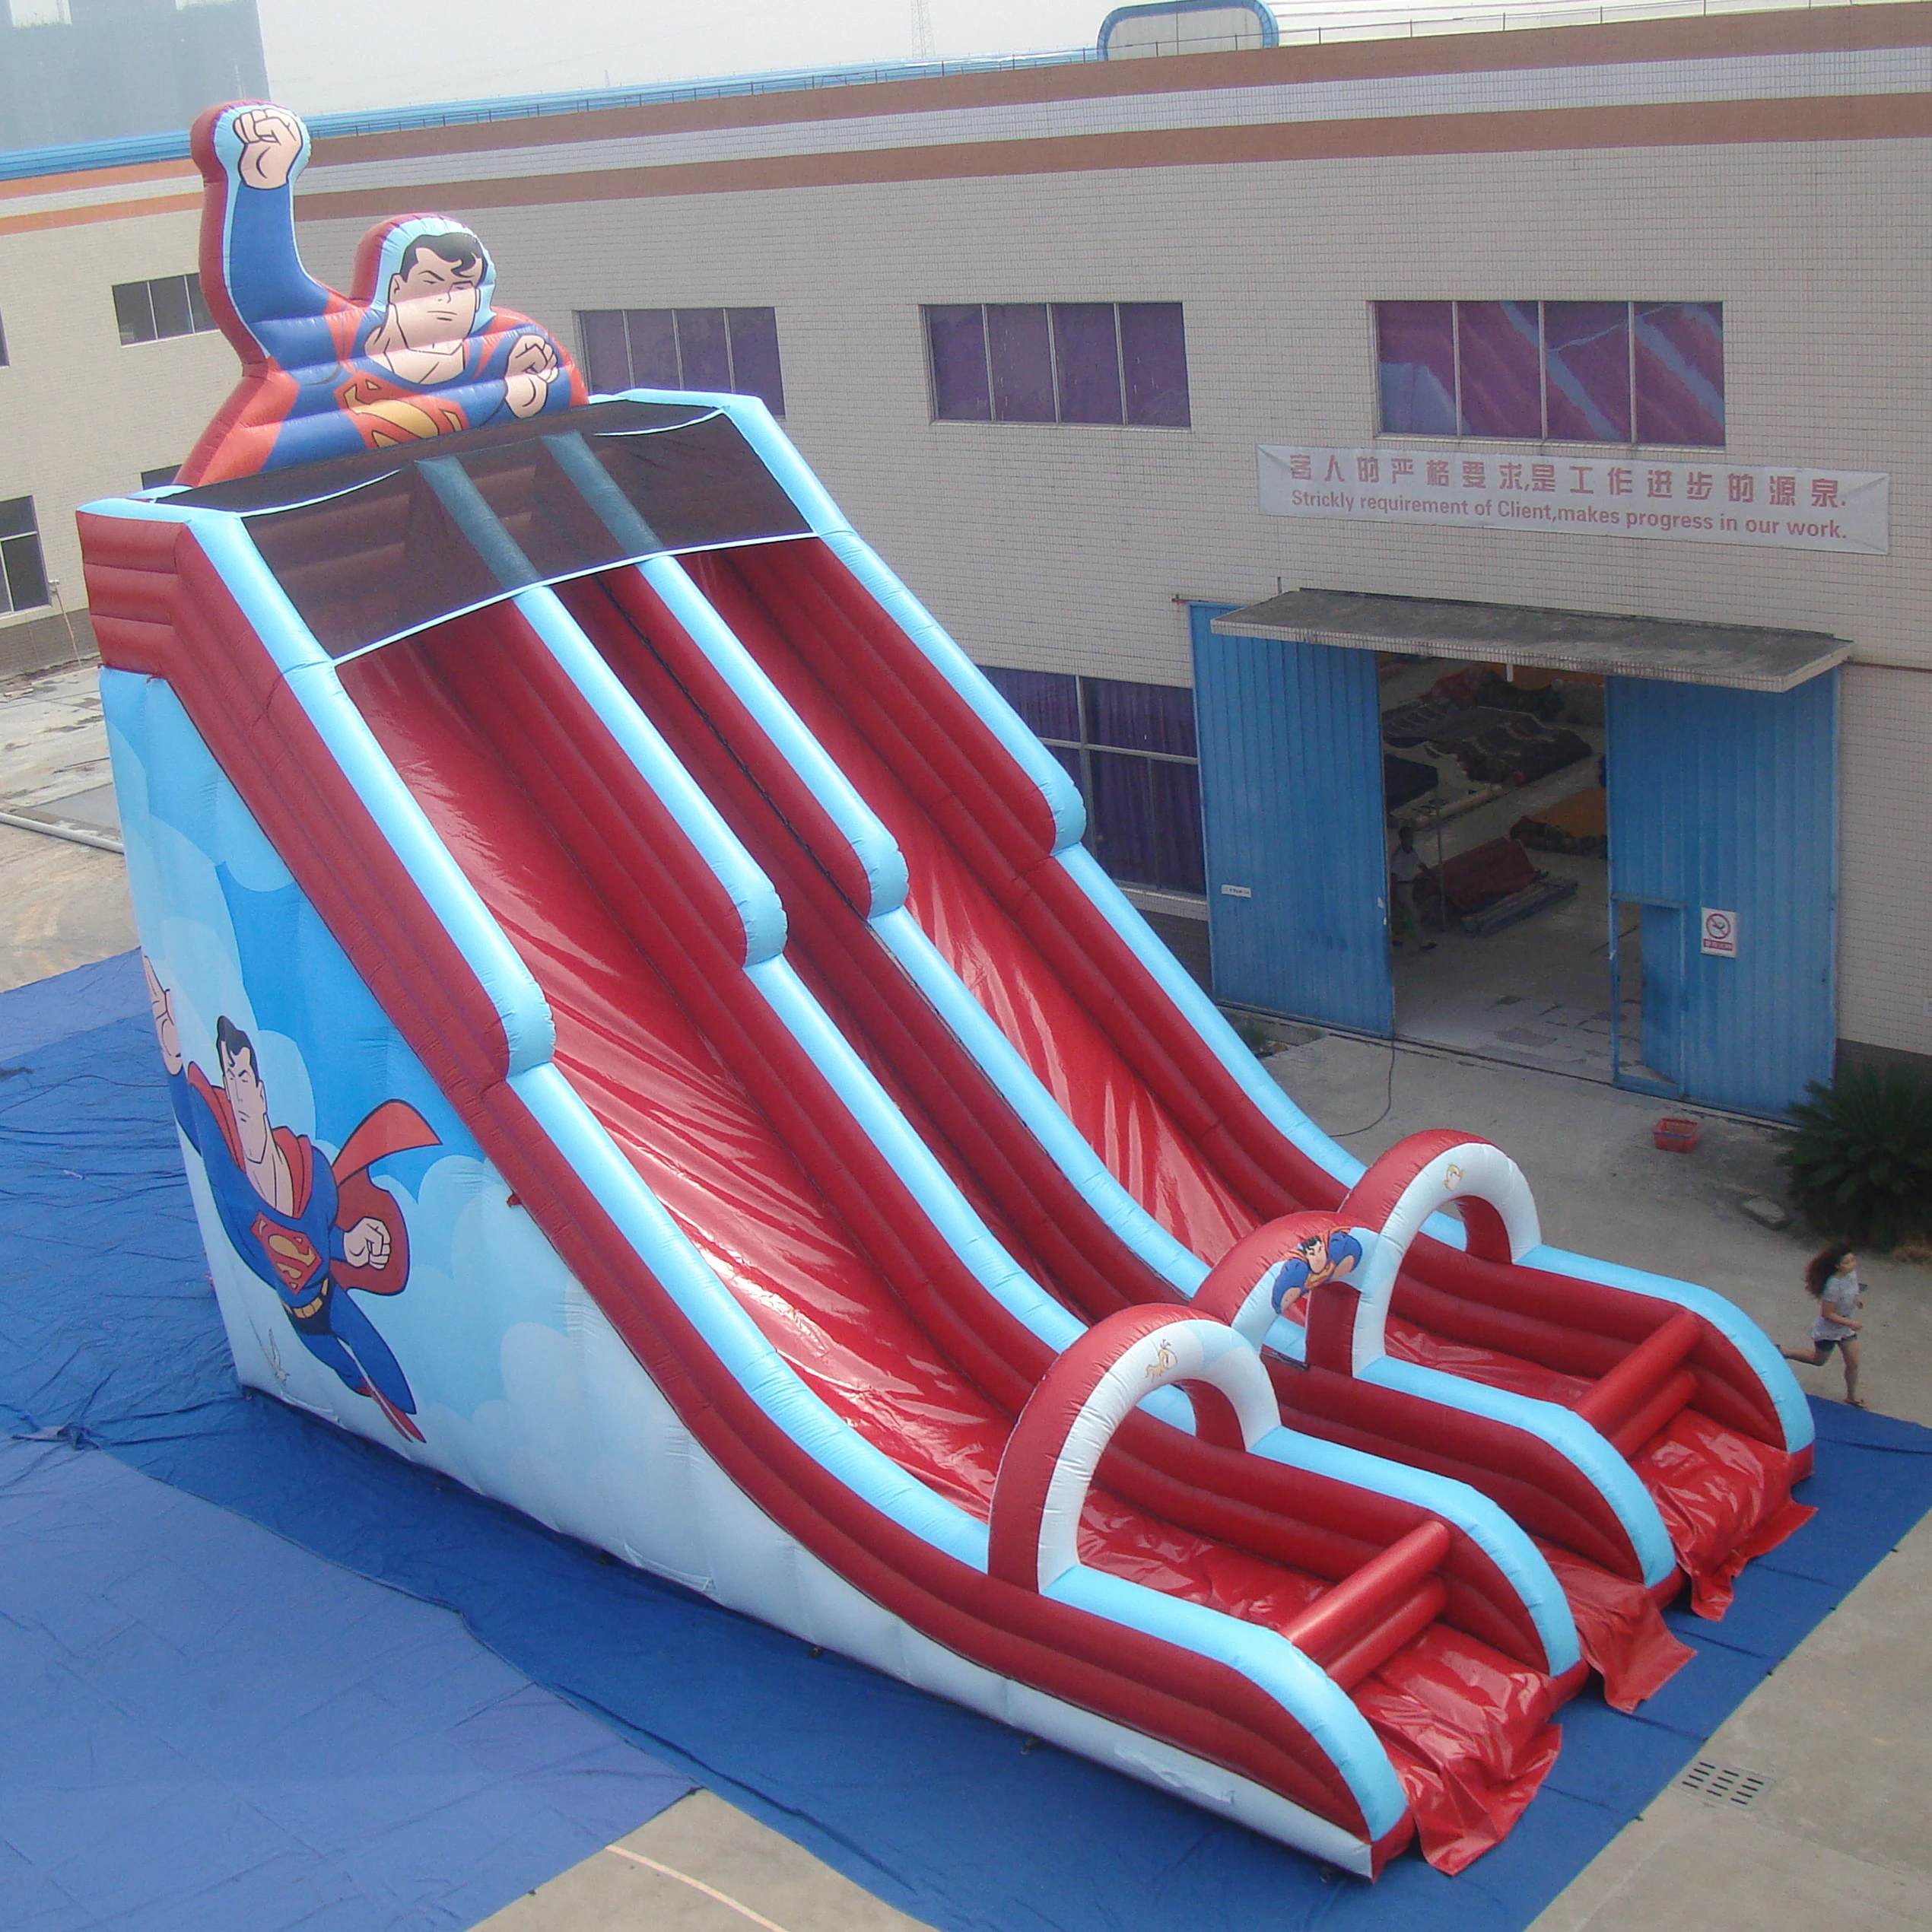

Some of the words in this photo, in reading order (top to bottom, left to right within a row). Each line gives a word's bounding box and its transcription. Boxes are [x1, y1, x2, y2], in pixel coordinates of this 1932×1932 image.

[1291, 490, 1355, 513] Strickly
[1360, 495, 1469, 516] requirement
[1474, 499, 1493, 516] of
[1498, 500, 1620, 524] Client,makes
[1625, 511, 1713, 531] progress
[1719, 513, 1737, 531] in
[1745, 519, 1780, 535] our
[1786, 520, 1847, 539] work.
